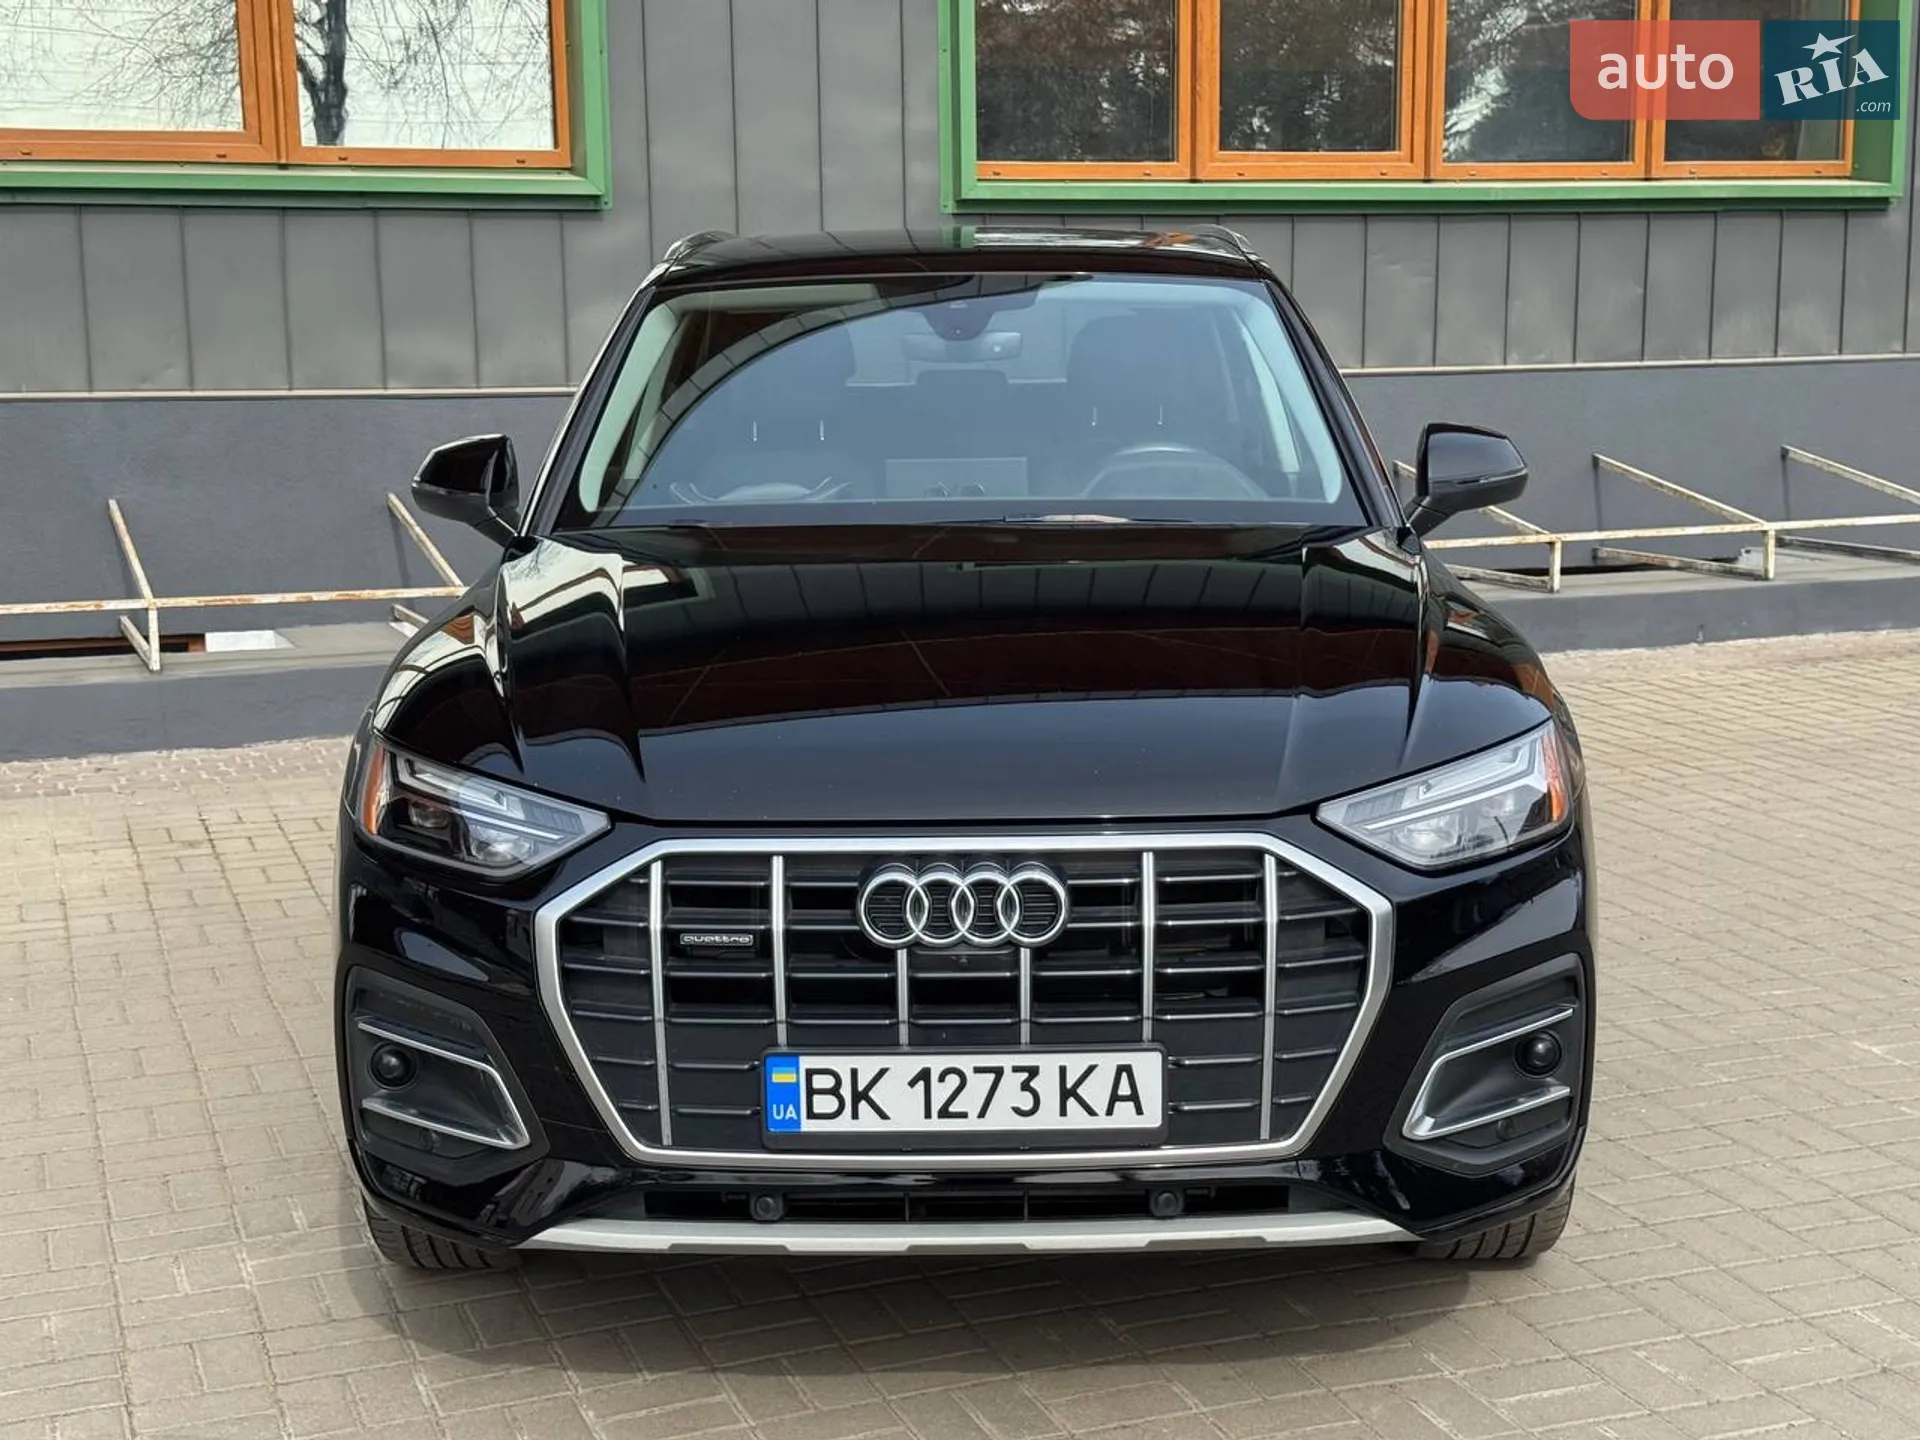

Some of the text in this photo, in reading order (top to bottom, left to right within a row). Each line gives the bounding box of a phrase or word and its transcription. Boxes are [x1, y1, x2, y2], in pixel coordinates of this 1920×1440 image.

[805, 1064, 1145, 1120] BK 1273 KA
[772, 1104, 798, 1120] UA
